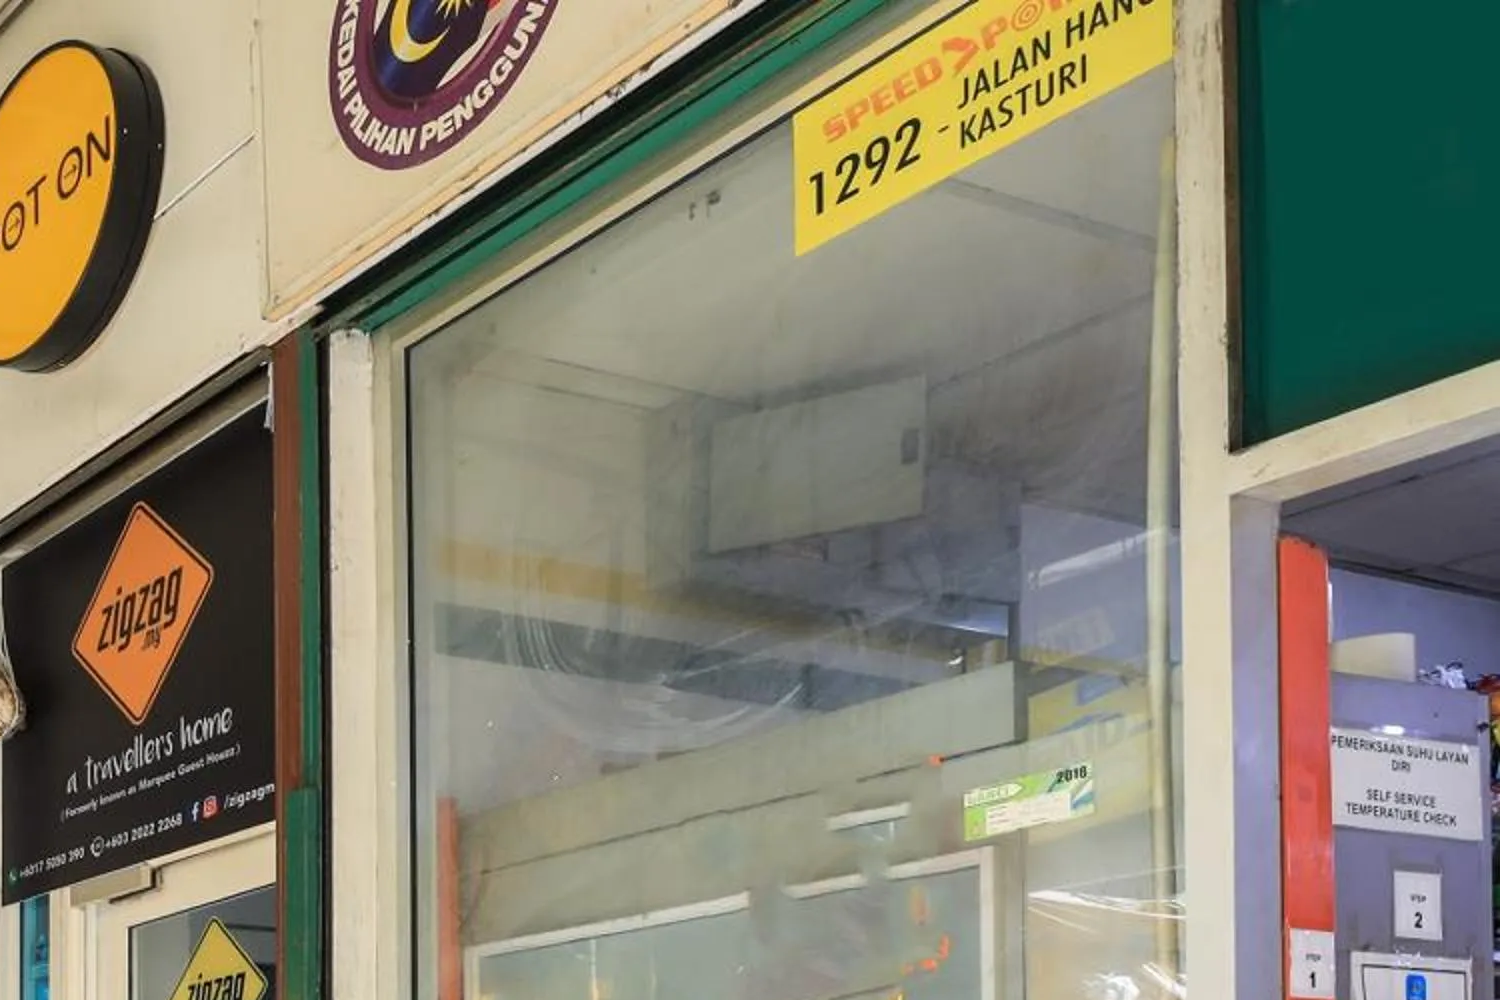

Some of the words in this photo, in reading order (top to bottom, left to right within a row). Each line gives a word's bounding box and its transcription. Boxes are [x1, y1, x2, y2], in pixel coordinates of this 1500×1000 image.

[338, 0, 359, 99] KEDAI
[419, 0, 549, 151] PENGGUN
[957, 30, 1051, 110] JALAN
[1065, 0, 1152, 49] HAN
[343, 92, 417, 155] PILIHAN
[959, 54, 1088, 149] KASTURI
[56, 115, 112, 201] ON
[808, 117, 923, 217] 1292
[96, 565, 185, 653] zigzag
[66, 771, 78, 795] a
[84, 730, 175, 790] travellers
[179, 707, 234, 750] home
[1331, 735, 1405, 756] PEMERIKSAAN
[1406, 745, 1434, 761] SUHU
[1435, 750, 1469, 766] LAYAN
[1390, 759, 1411, 773] DIRI
[1345, 802, 1421, 823] TEMPERATURE
[1423, 811, 1458, 827] CHECK
[1365, 788, 1392, 802] SELF
[1393, 791, 1437, 809] SERVICE
[1414, 911, 1423, 929] 2
[1308, 971, 1317, 988] 1
